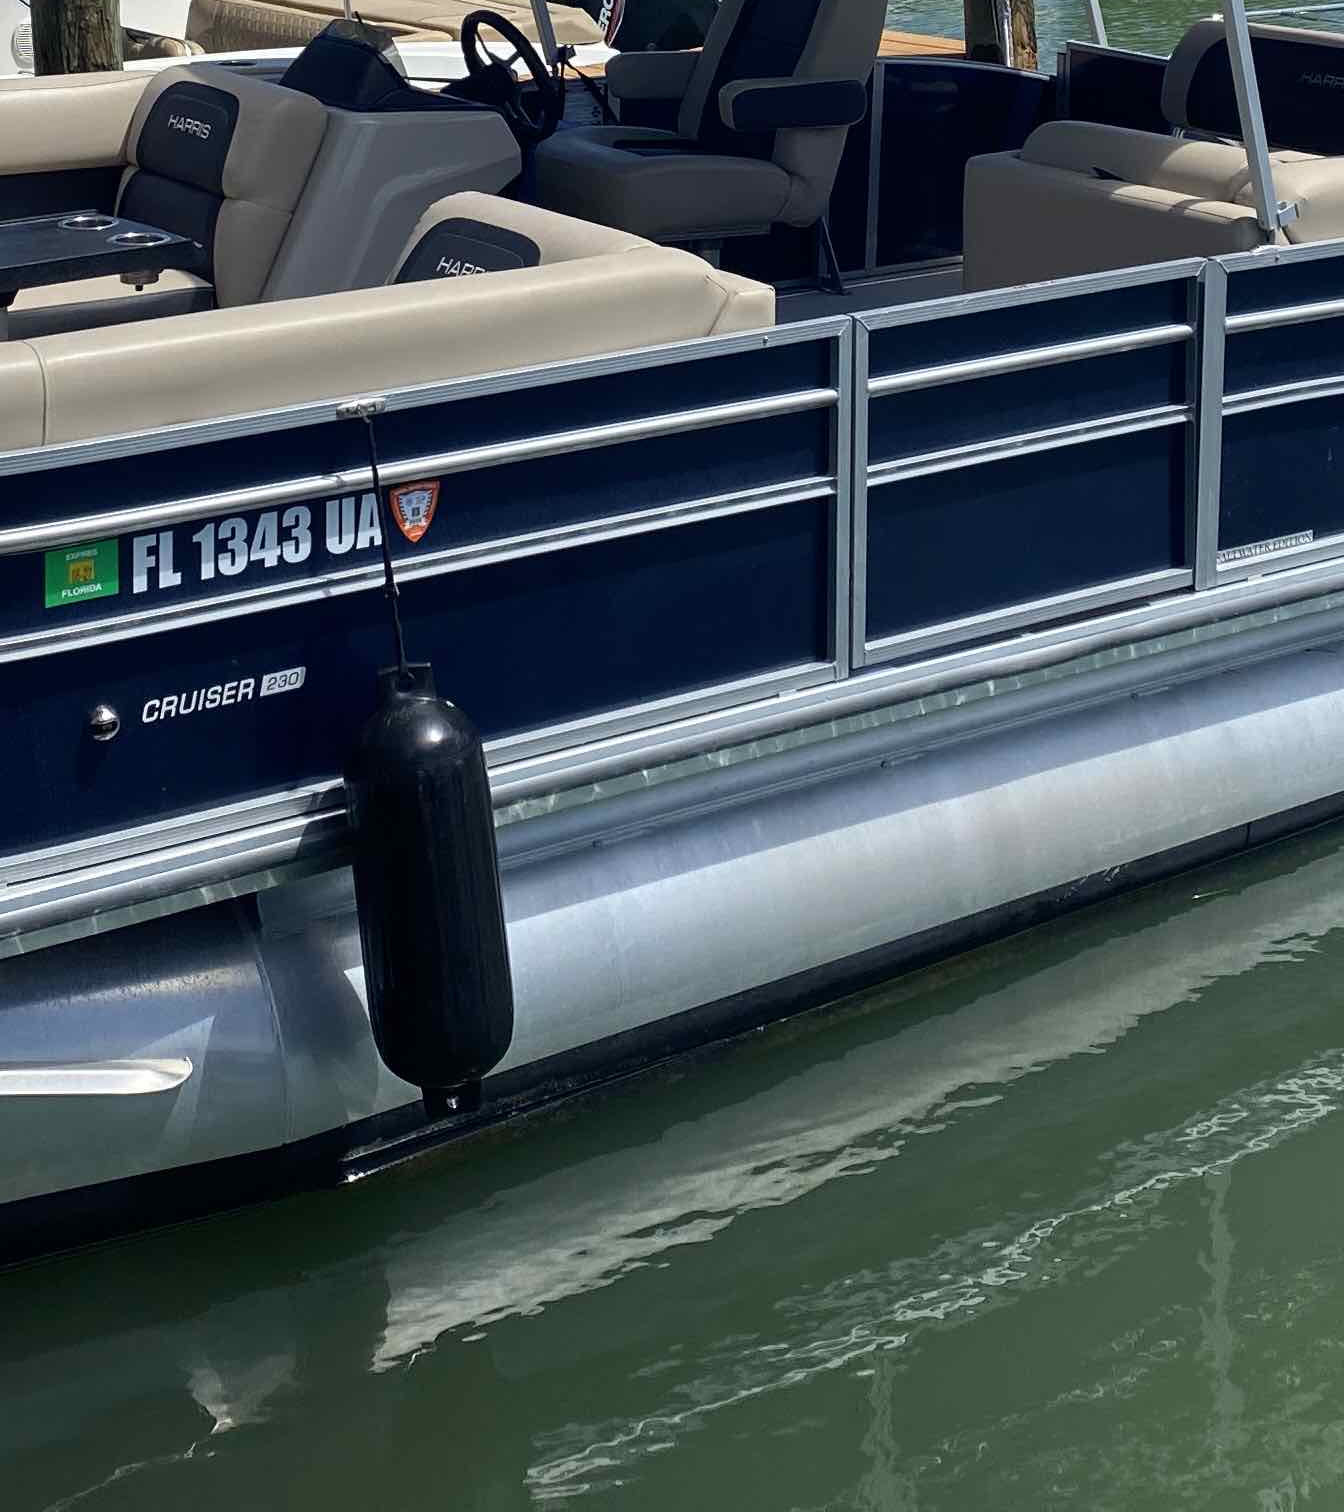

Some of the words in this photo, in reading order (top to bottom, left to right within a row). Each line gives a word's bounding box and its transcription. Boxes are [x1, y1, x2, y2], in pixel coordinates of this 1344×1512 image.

[167, 114, 212, 140] HARRIS
[436, 256, 486, 279] HAR
[132, 530, 182, 595] FL
[192, 505, 312, 582] 1343
[325, 492, 383, 556] UA
[1216, 542, 1274, 565] SALTWATER
[1273, 531, 1313, 552] EDITION
[61, 583, 103, 599] FLORIDA
[141, 677, 256, 724] CRUISER
[267, 671, 300, 691] 230
